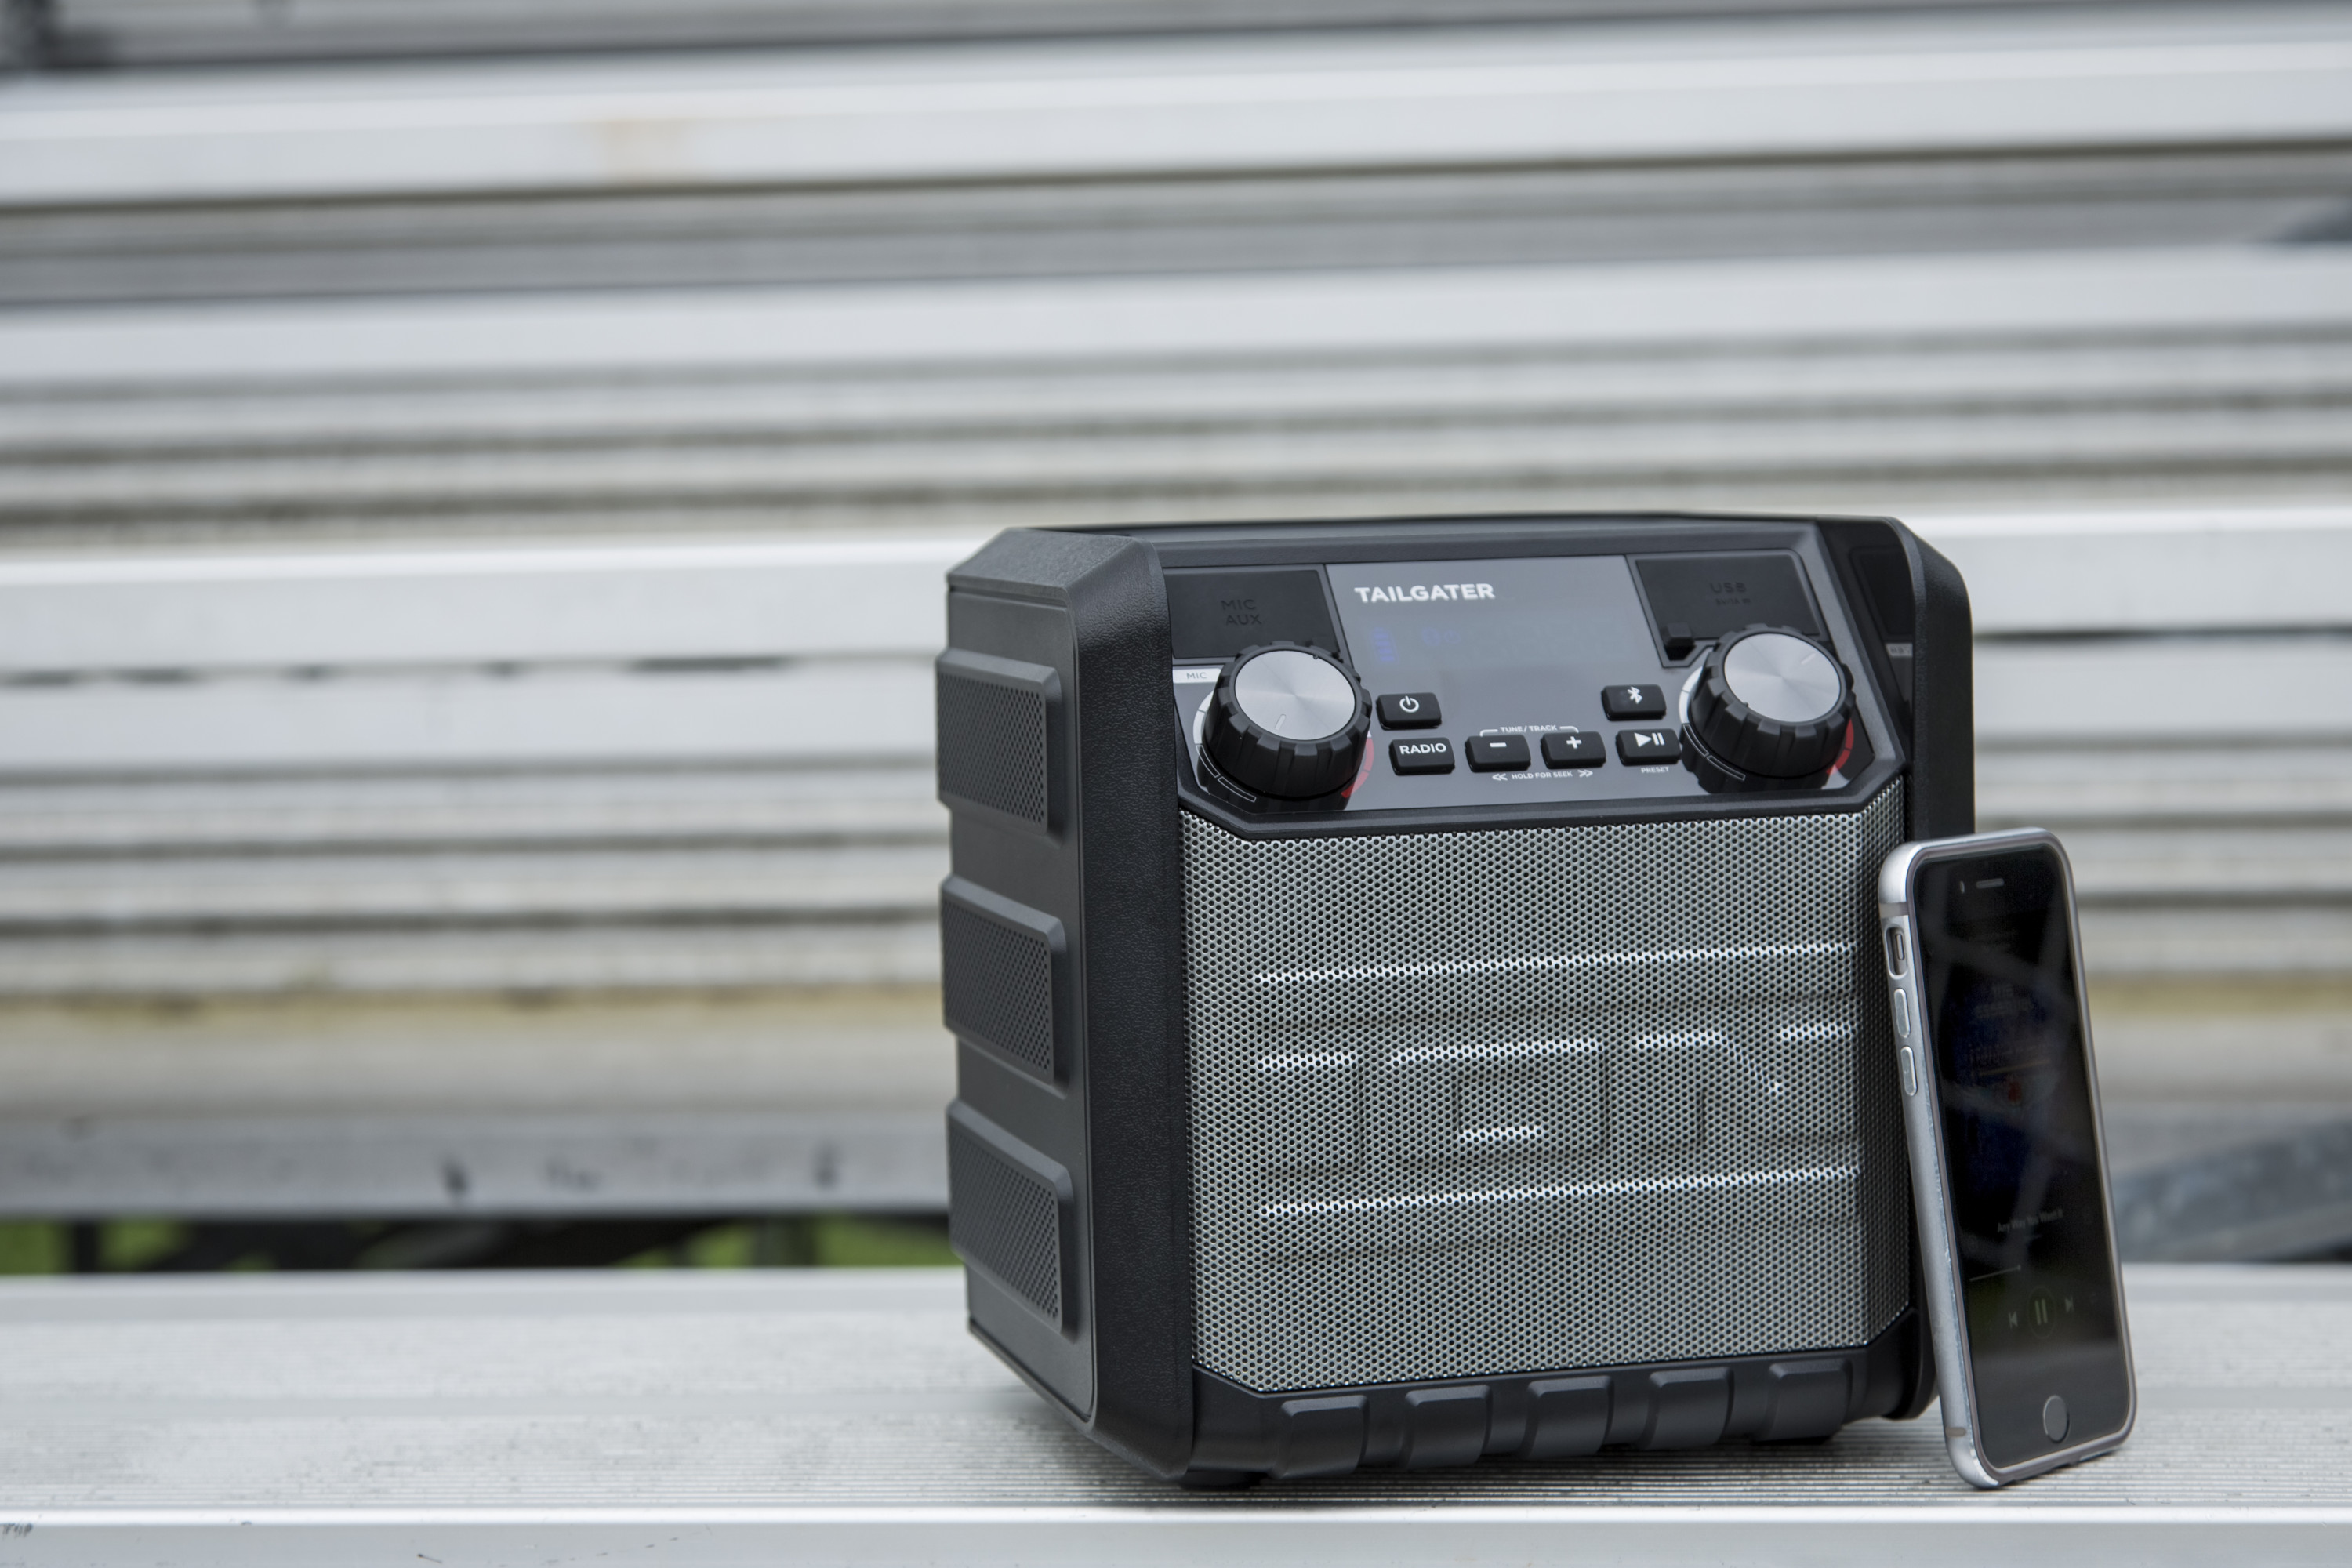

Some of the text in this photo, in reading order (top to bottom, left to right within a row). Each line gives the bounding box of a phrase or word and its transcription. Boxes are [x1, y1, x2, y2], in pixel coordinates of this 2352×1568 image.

[1354, 583, 1496, 604] TAILGATER
[1708, 582, 1748, 594] USB
[1220, 598, 1257, 611] MIC
[1225, 613, 1263, 626] AUX
[1186, 671, 1208, 680] MIC
[1399, 742, 1447, 755] RADIO
